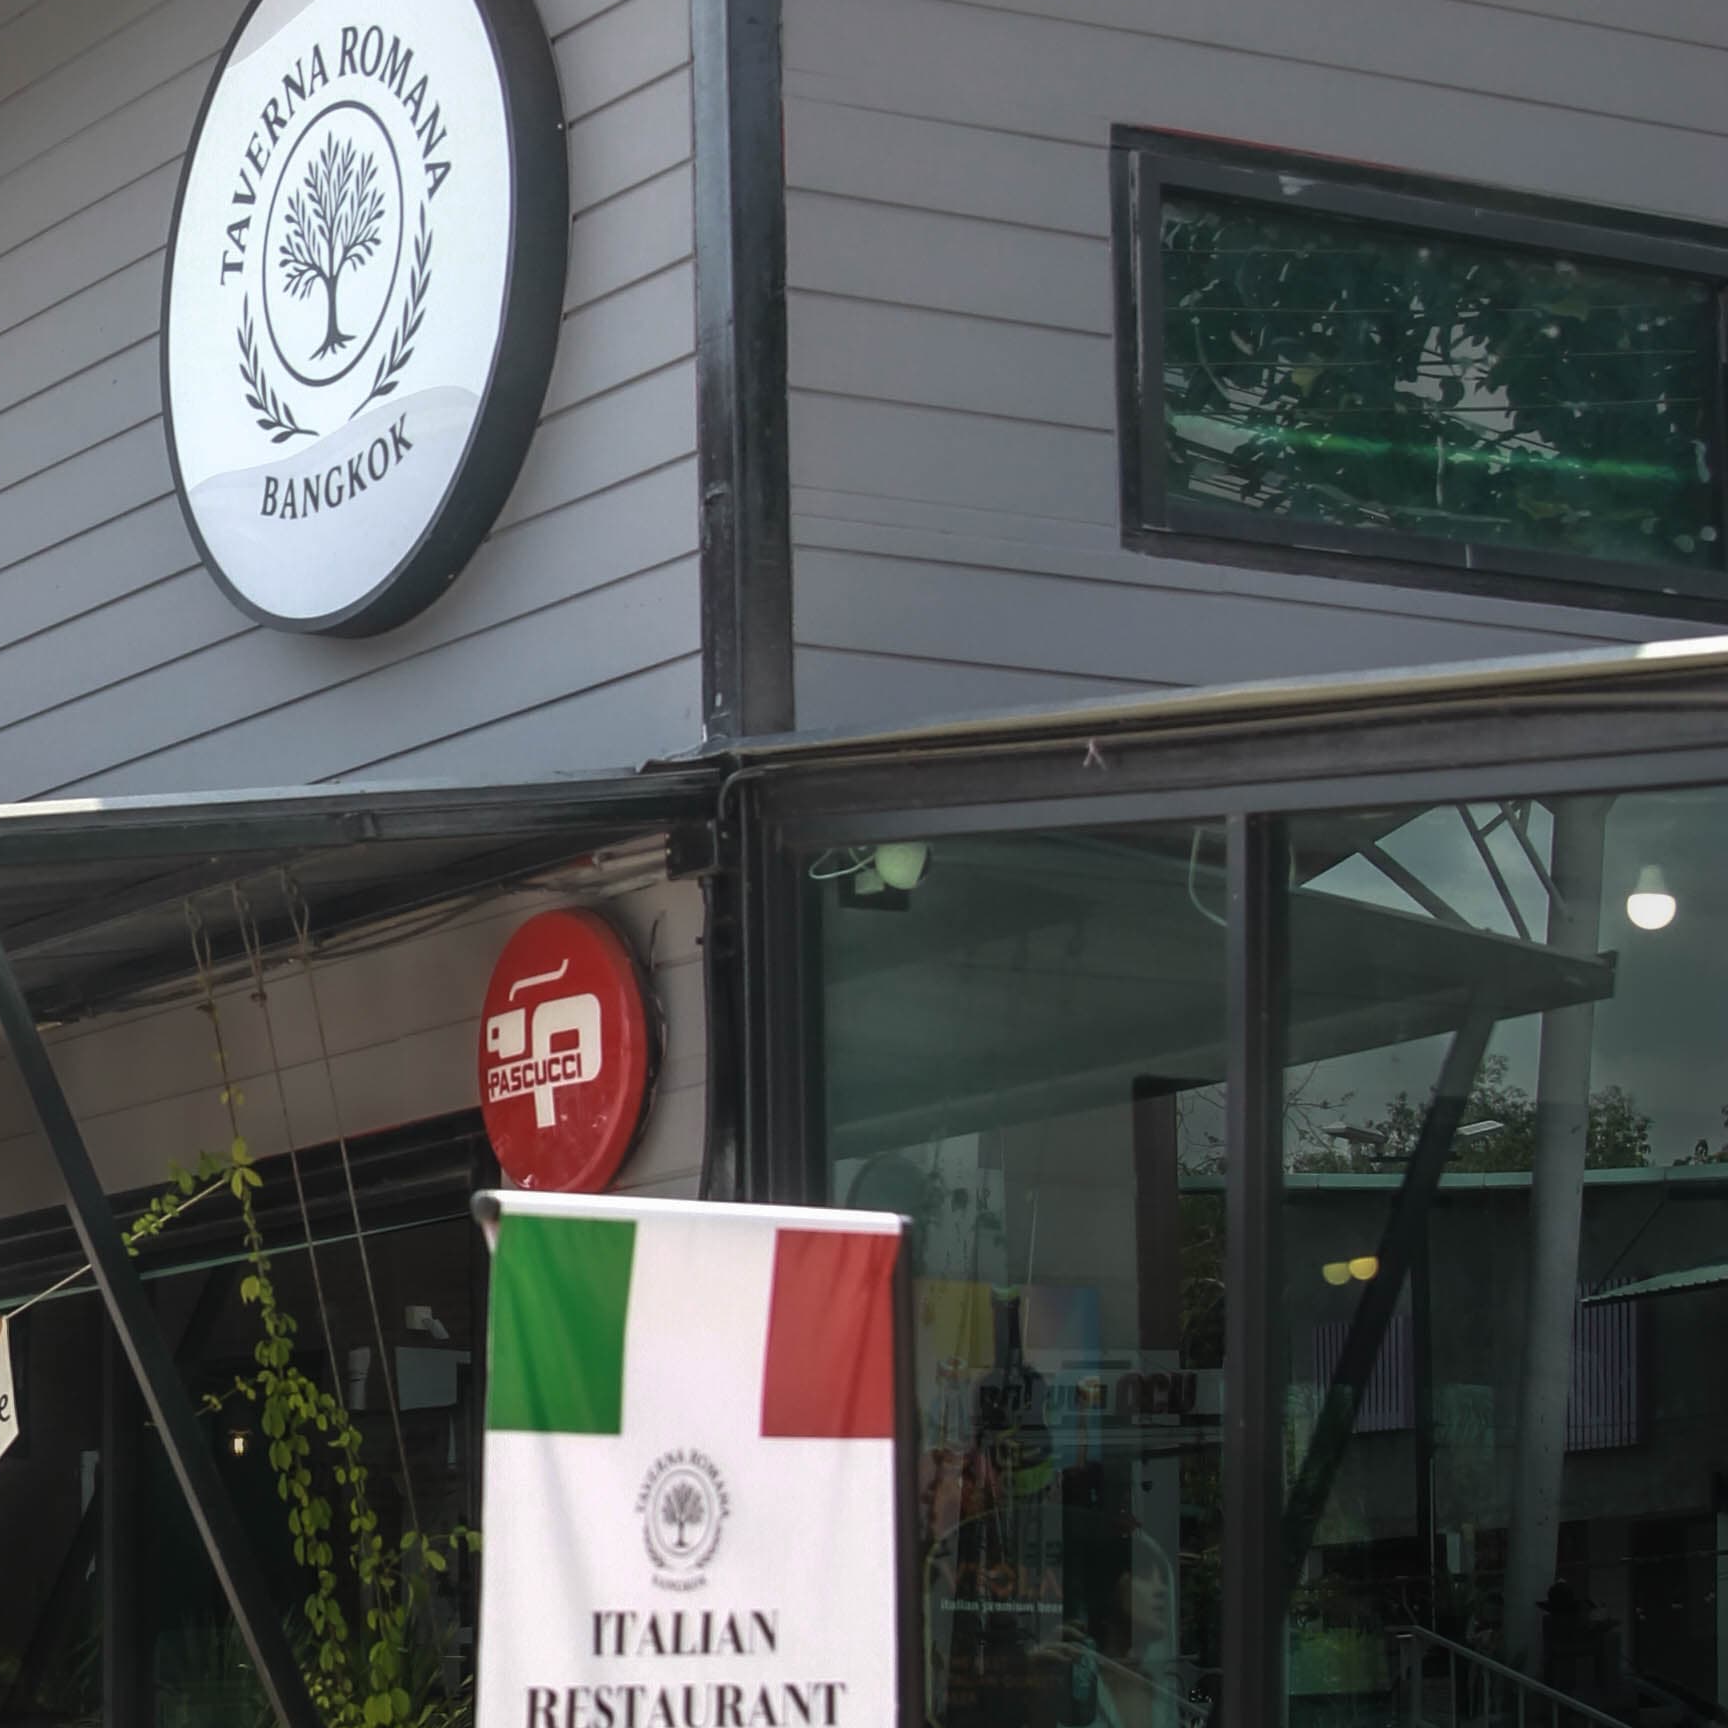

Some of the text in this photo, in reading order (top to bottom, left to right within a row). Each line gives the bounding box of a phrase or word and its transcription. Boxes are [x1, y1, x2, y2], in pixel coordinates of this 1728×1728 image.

[219, 23, 453, 286] TAVERNA ROMANA
[259, 412, 416, 521] BANGKOK
[488, 1052, 583, 1098] PASCUCCI
[591, 1608, 780, 1658] ITALIAN
